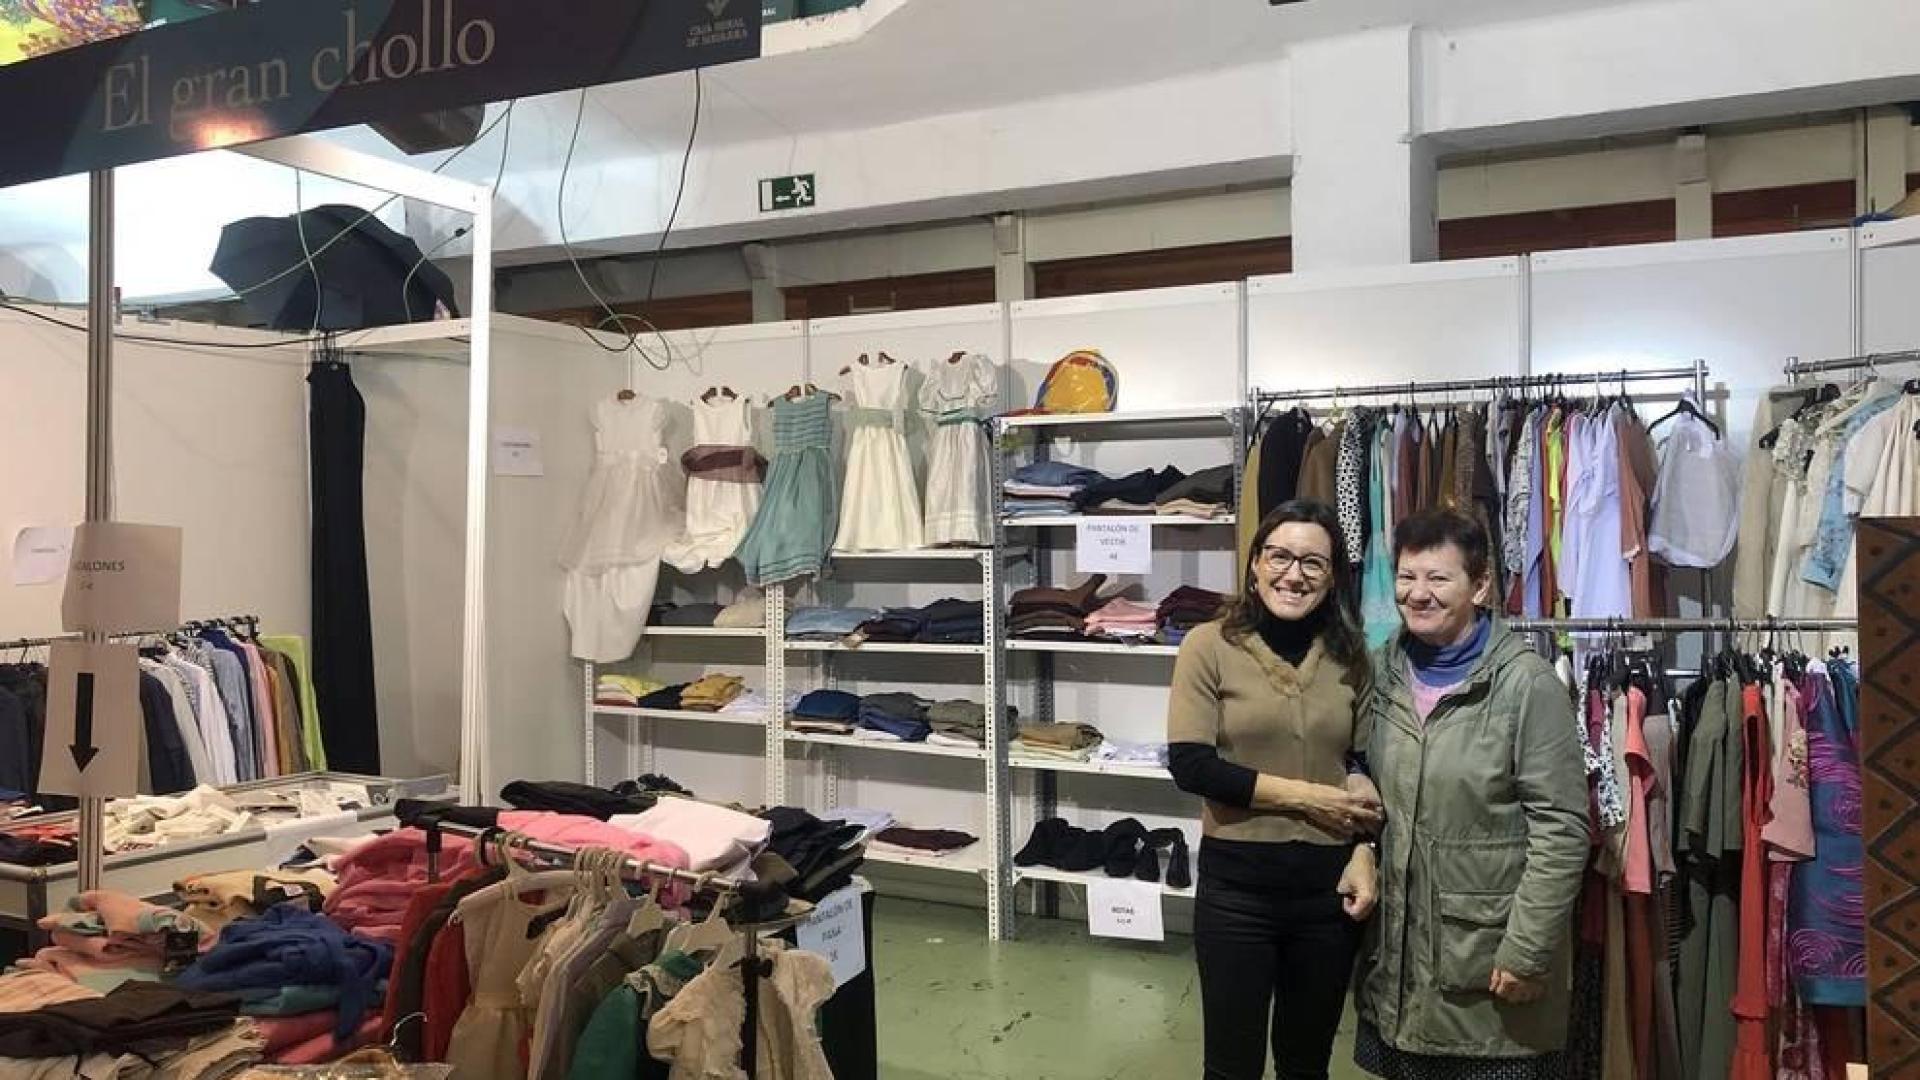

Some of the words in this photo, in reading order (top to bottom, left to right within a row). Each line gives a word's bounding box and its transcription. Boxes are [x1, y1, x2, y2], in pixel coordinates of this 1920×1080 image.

[104, 55, 152, 130] El
[169, 57, 290, 143] gran
[311, 0, 496, 91] chollo
